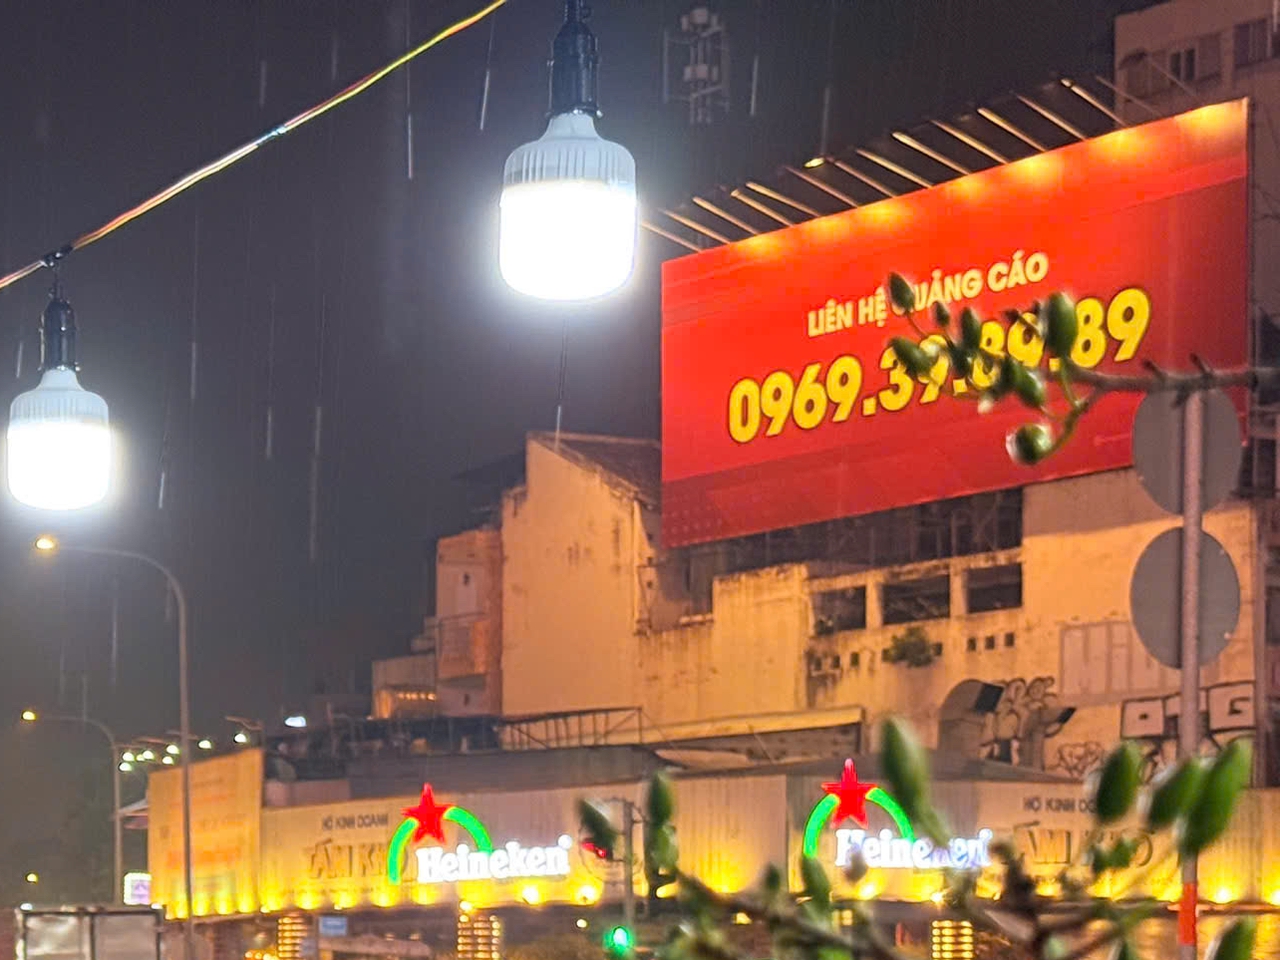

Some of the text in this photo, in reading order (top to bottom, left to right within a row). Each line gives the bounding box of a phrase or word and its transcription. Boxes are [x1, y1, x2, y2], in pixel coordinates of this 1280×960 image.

[808, 250, 1048, 338] LIÊN HỆ UẢNG CÁO
[415, 838, 571, 884] Heineken
